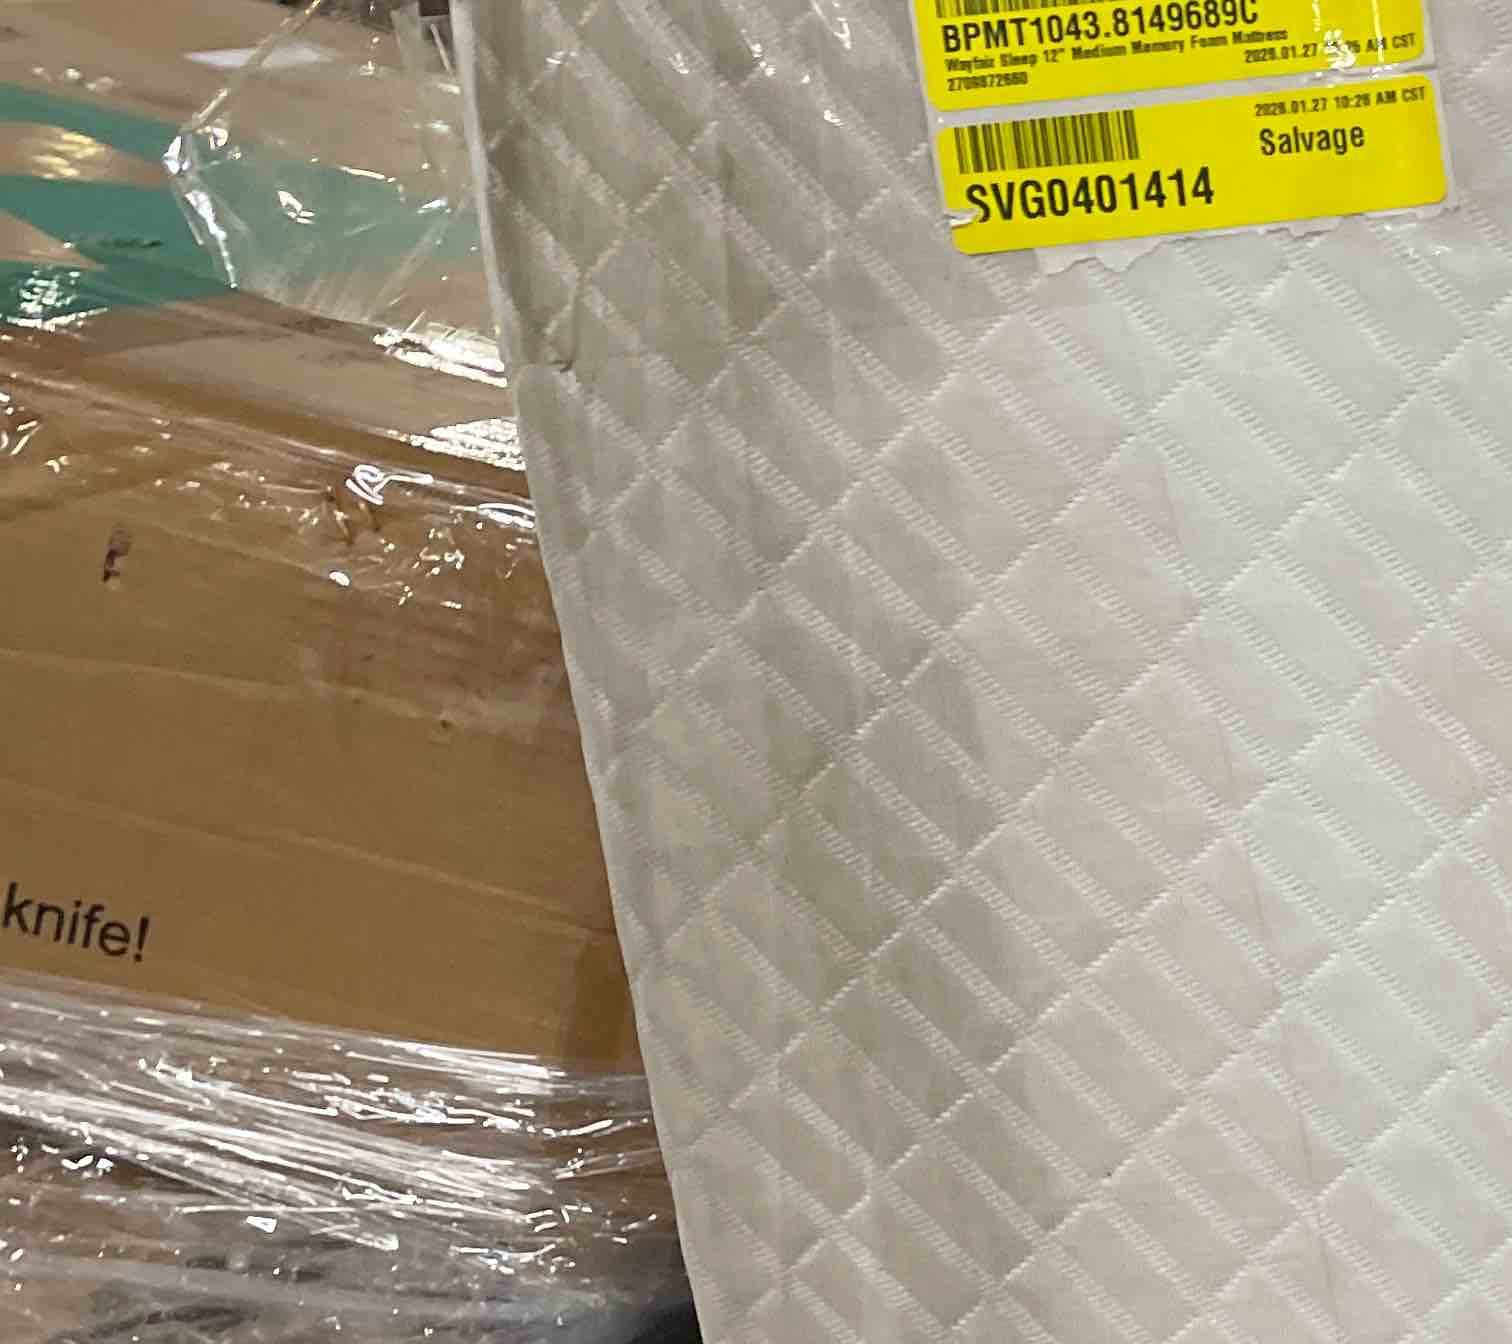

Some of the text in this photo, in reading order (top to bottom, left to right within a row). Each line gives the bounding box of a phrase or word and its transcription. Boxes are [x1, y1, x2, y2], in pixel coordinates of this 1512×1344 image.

[1043, 47, 1066, 63] 12"
[1071, 44, 1128, 61] Medium
[1131, 38, 1185, 54] Memory
[1190, 33, 1228, 48] Foam
[1232, 29, 1289, 44] Mattress
[1391, 32, 1417, 48] CST
[1376, 90, 1398, 106] AM
[1402, 86, 1426, 103] CST
[1259, 126, 1366, 157] Salvage
[965, 166, 1215, 224] SVG0401414
[2, 881, 150, 964] knife!
